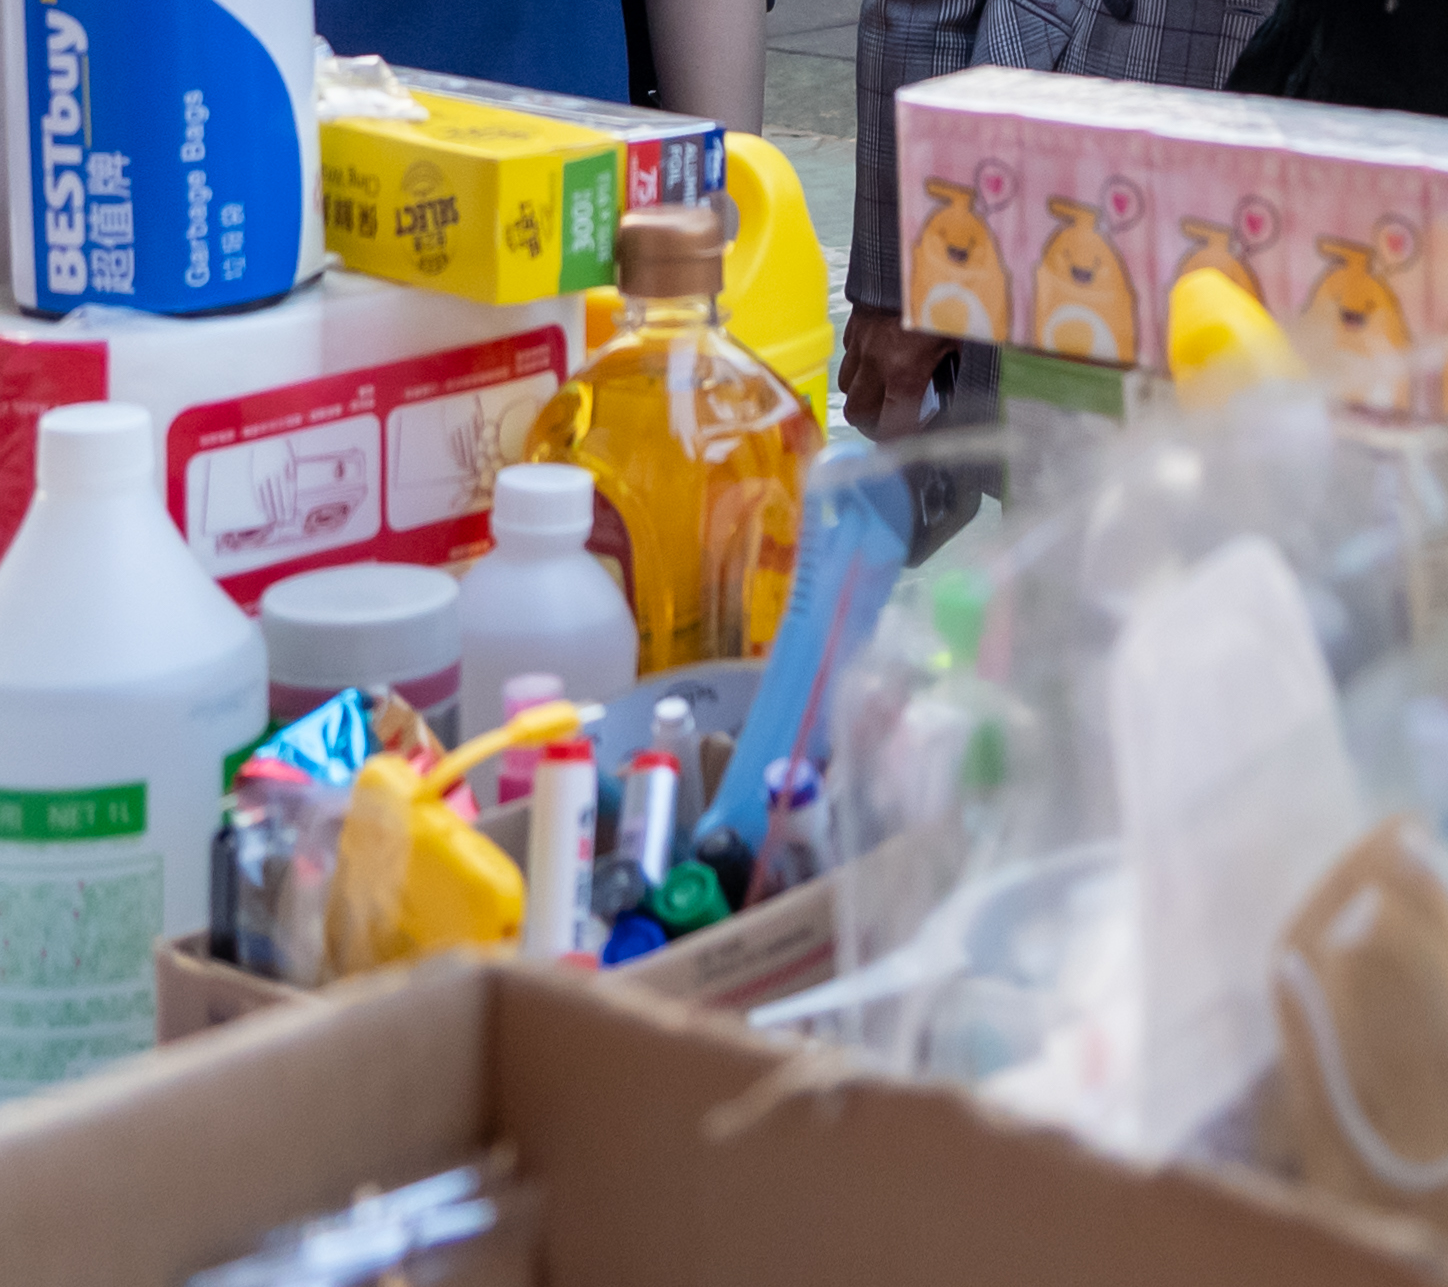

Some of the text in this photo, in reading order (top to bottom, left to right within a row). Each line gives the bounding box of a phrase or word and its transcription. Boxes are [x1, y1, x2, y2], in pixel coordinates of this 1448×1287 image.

[41, 8, 89, 295] BESTbuy
[86, 150, 135, 295] 超值牌
[180, 89, 212, 288] Garbage Bags
[395, 195, 460, 237] SELECT
[666, 143, 683, 190] FOIL
